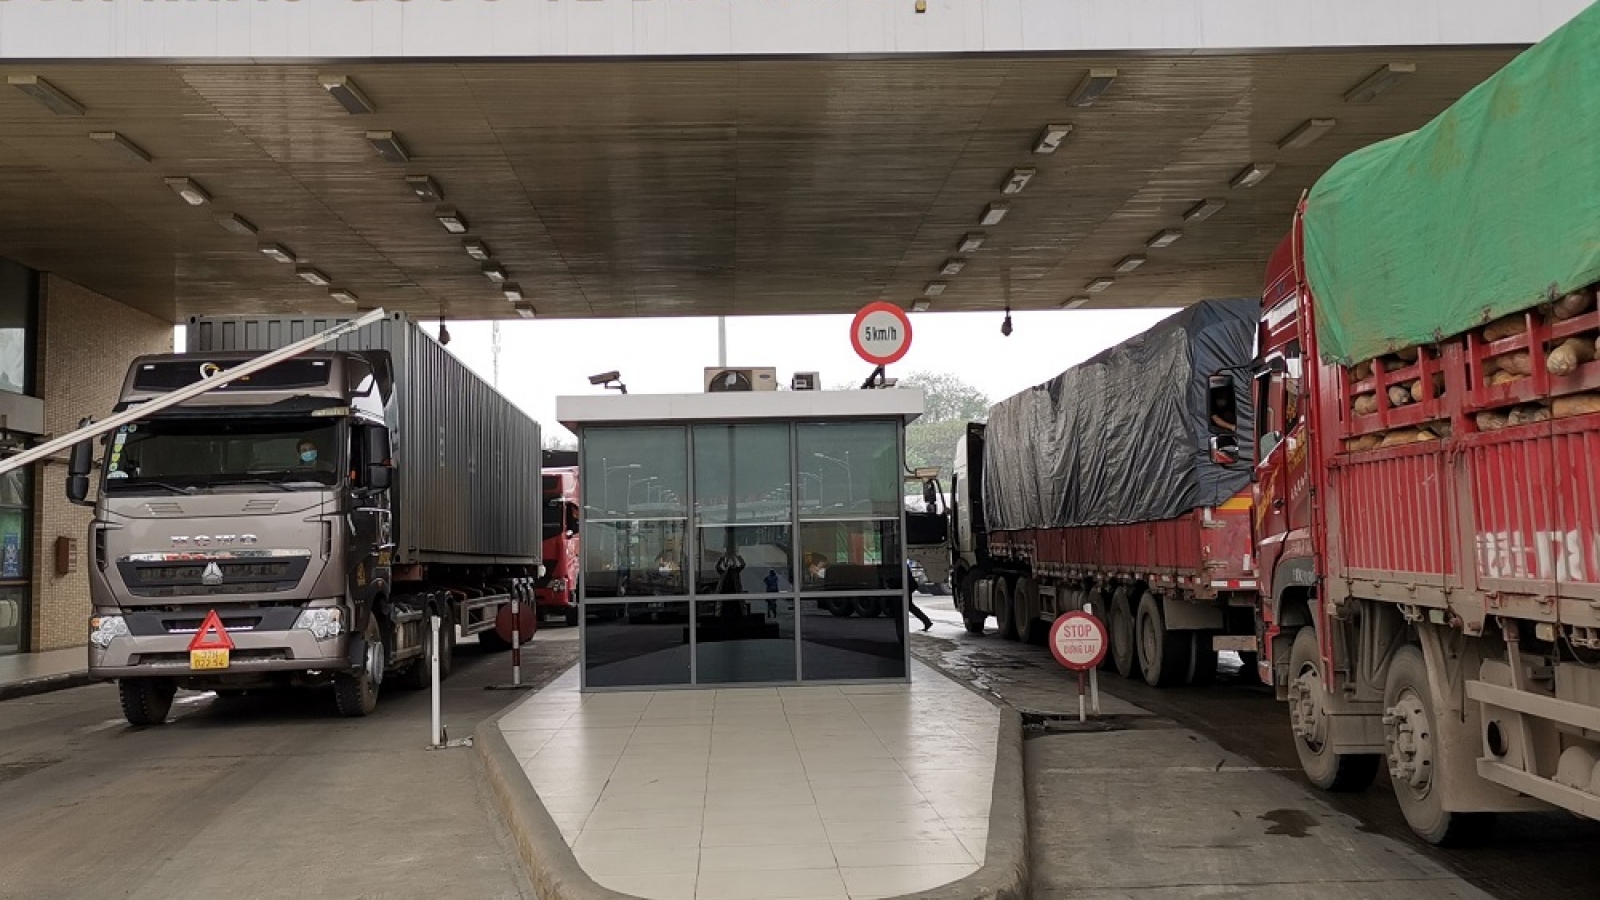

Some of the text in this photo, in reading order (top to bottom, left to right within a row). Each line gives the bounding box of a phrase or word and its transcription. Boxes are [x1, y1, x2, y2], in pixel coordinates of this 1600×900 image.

[865, 326, 897, 341] 5 km/h
[1063, 624, 1092, 638] STOP
